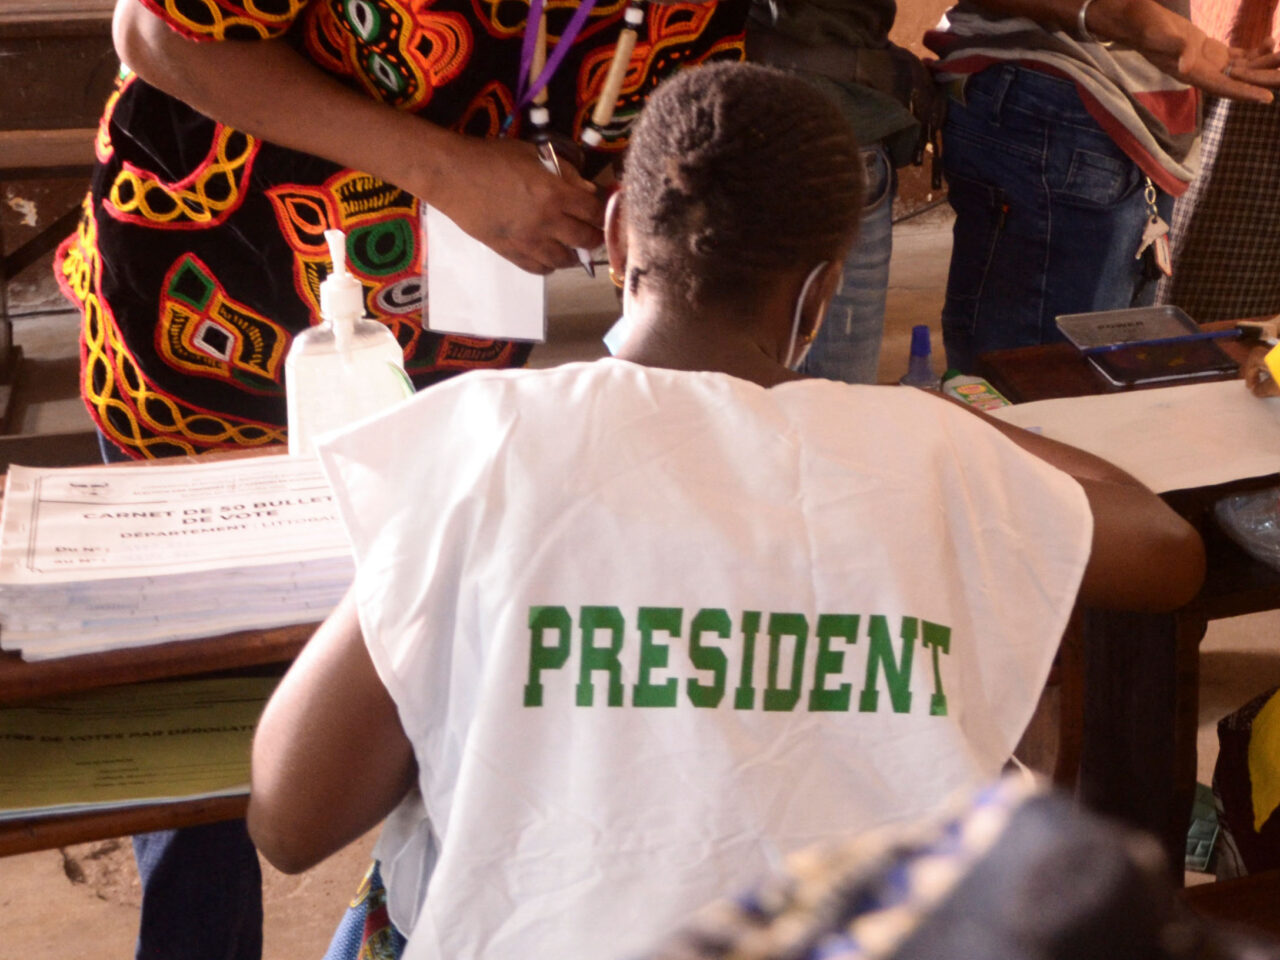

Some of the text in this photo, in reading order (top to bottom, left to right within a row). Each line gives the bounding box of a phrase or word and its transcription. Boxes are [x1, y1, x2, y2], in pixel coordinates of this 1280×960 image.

[82, 495, 334, 520] CARNET DE 50 BULLET
[181, 509, 279, 525] DE VOTE
[523, 605, 952, 717] PRESIDENT
